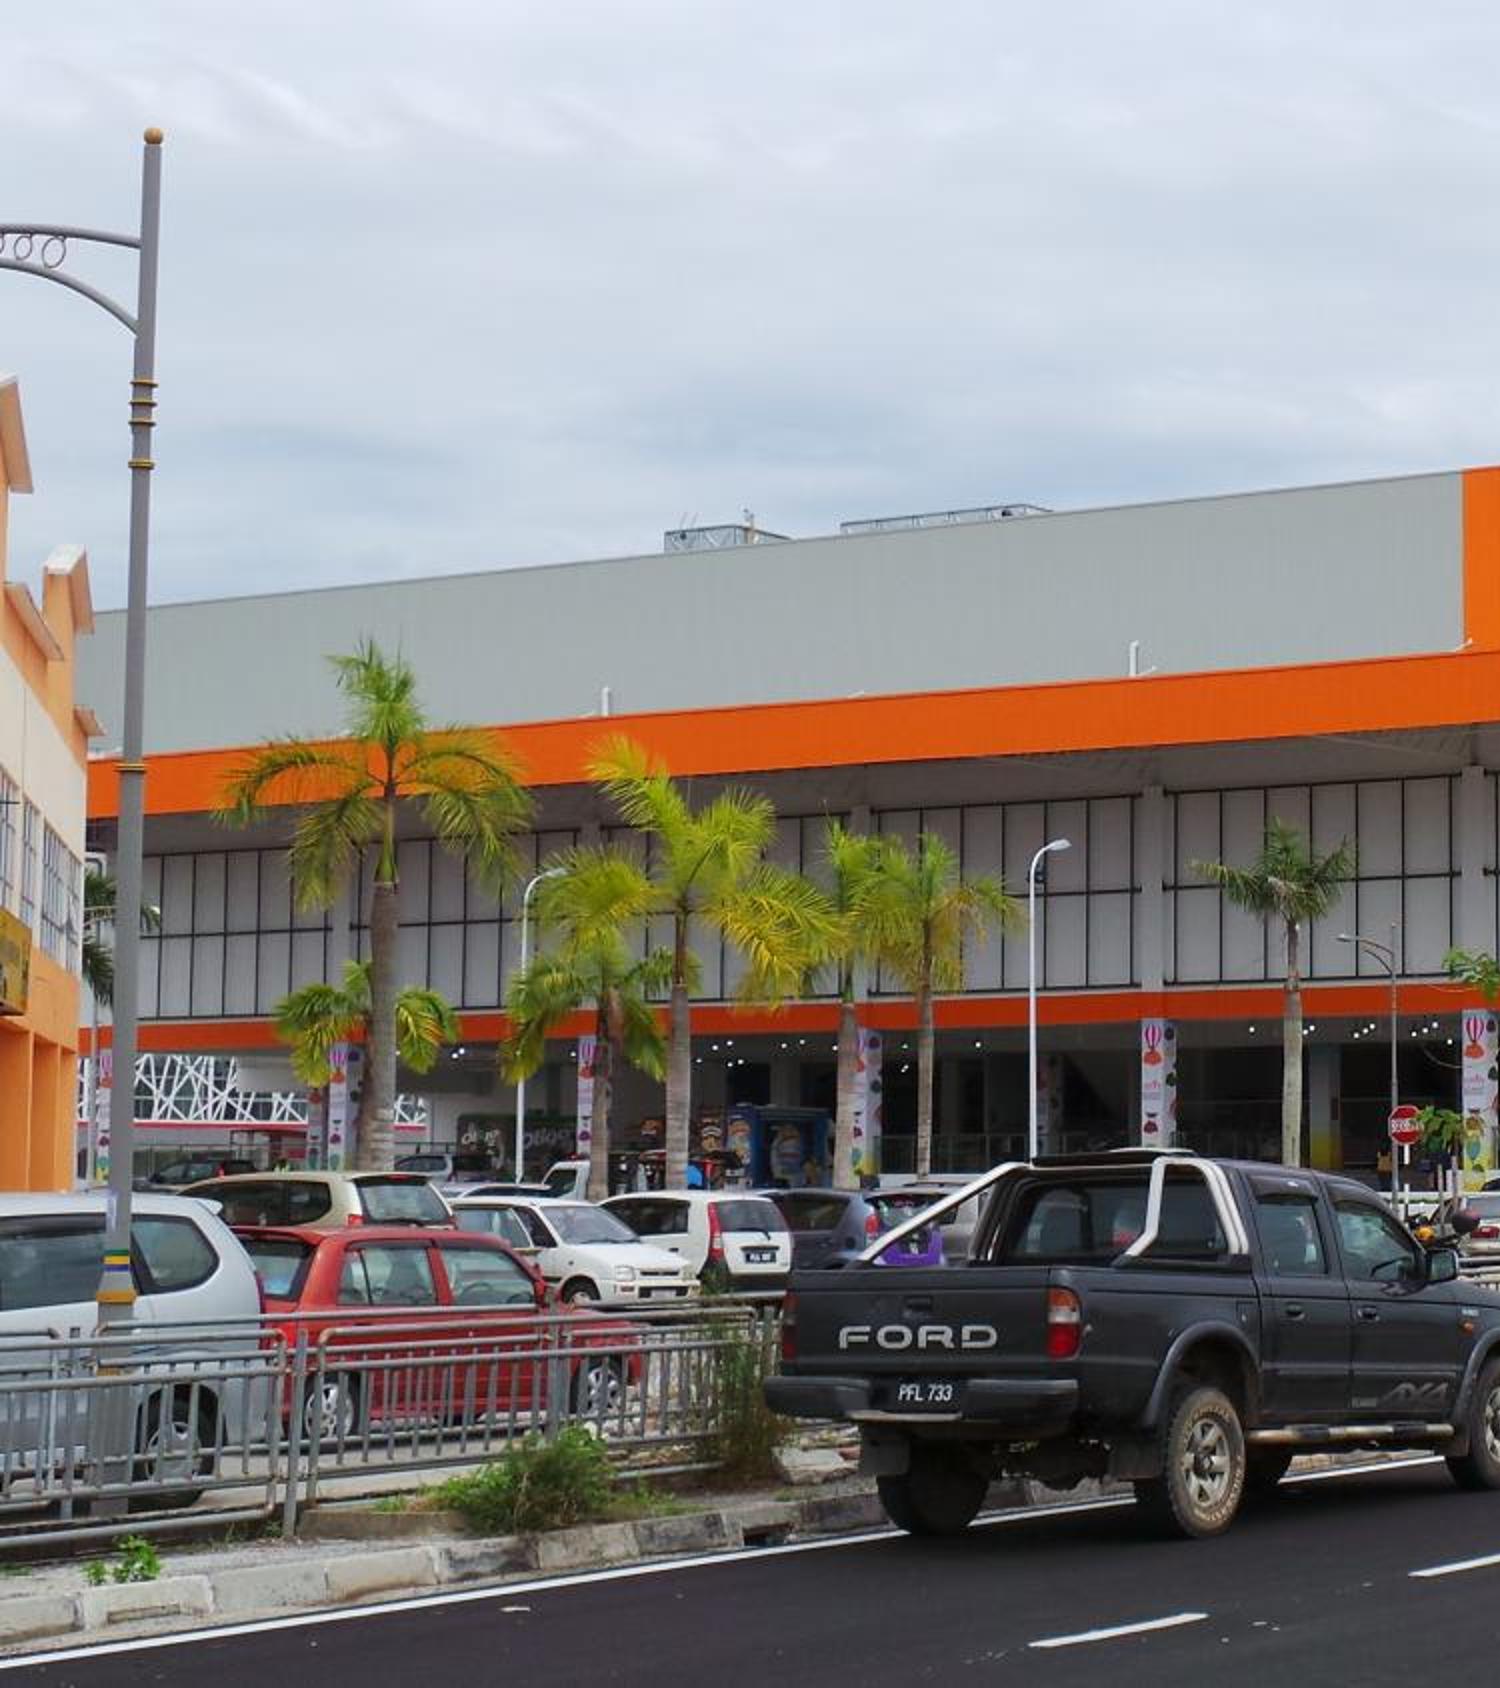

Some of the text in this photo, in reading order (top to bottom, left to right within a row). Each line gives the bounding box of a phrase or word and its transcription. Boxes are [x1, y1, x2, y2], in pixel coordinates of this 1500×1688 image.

[838, 1325, 998, 1349] FORD
[898, 1384, 953, 1401] PFL 733
